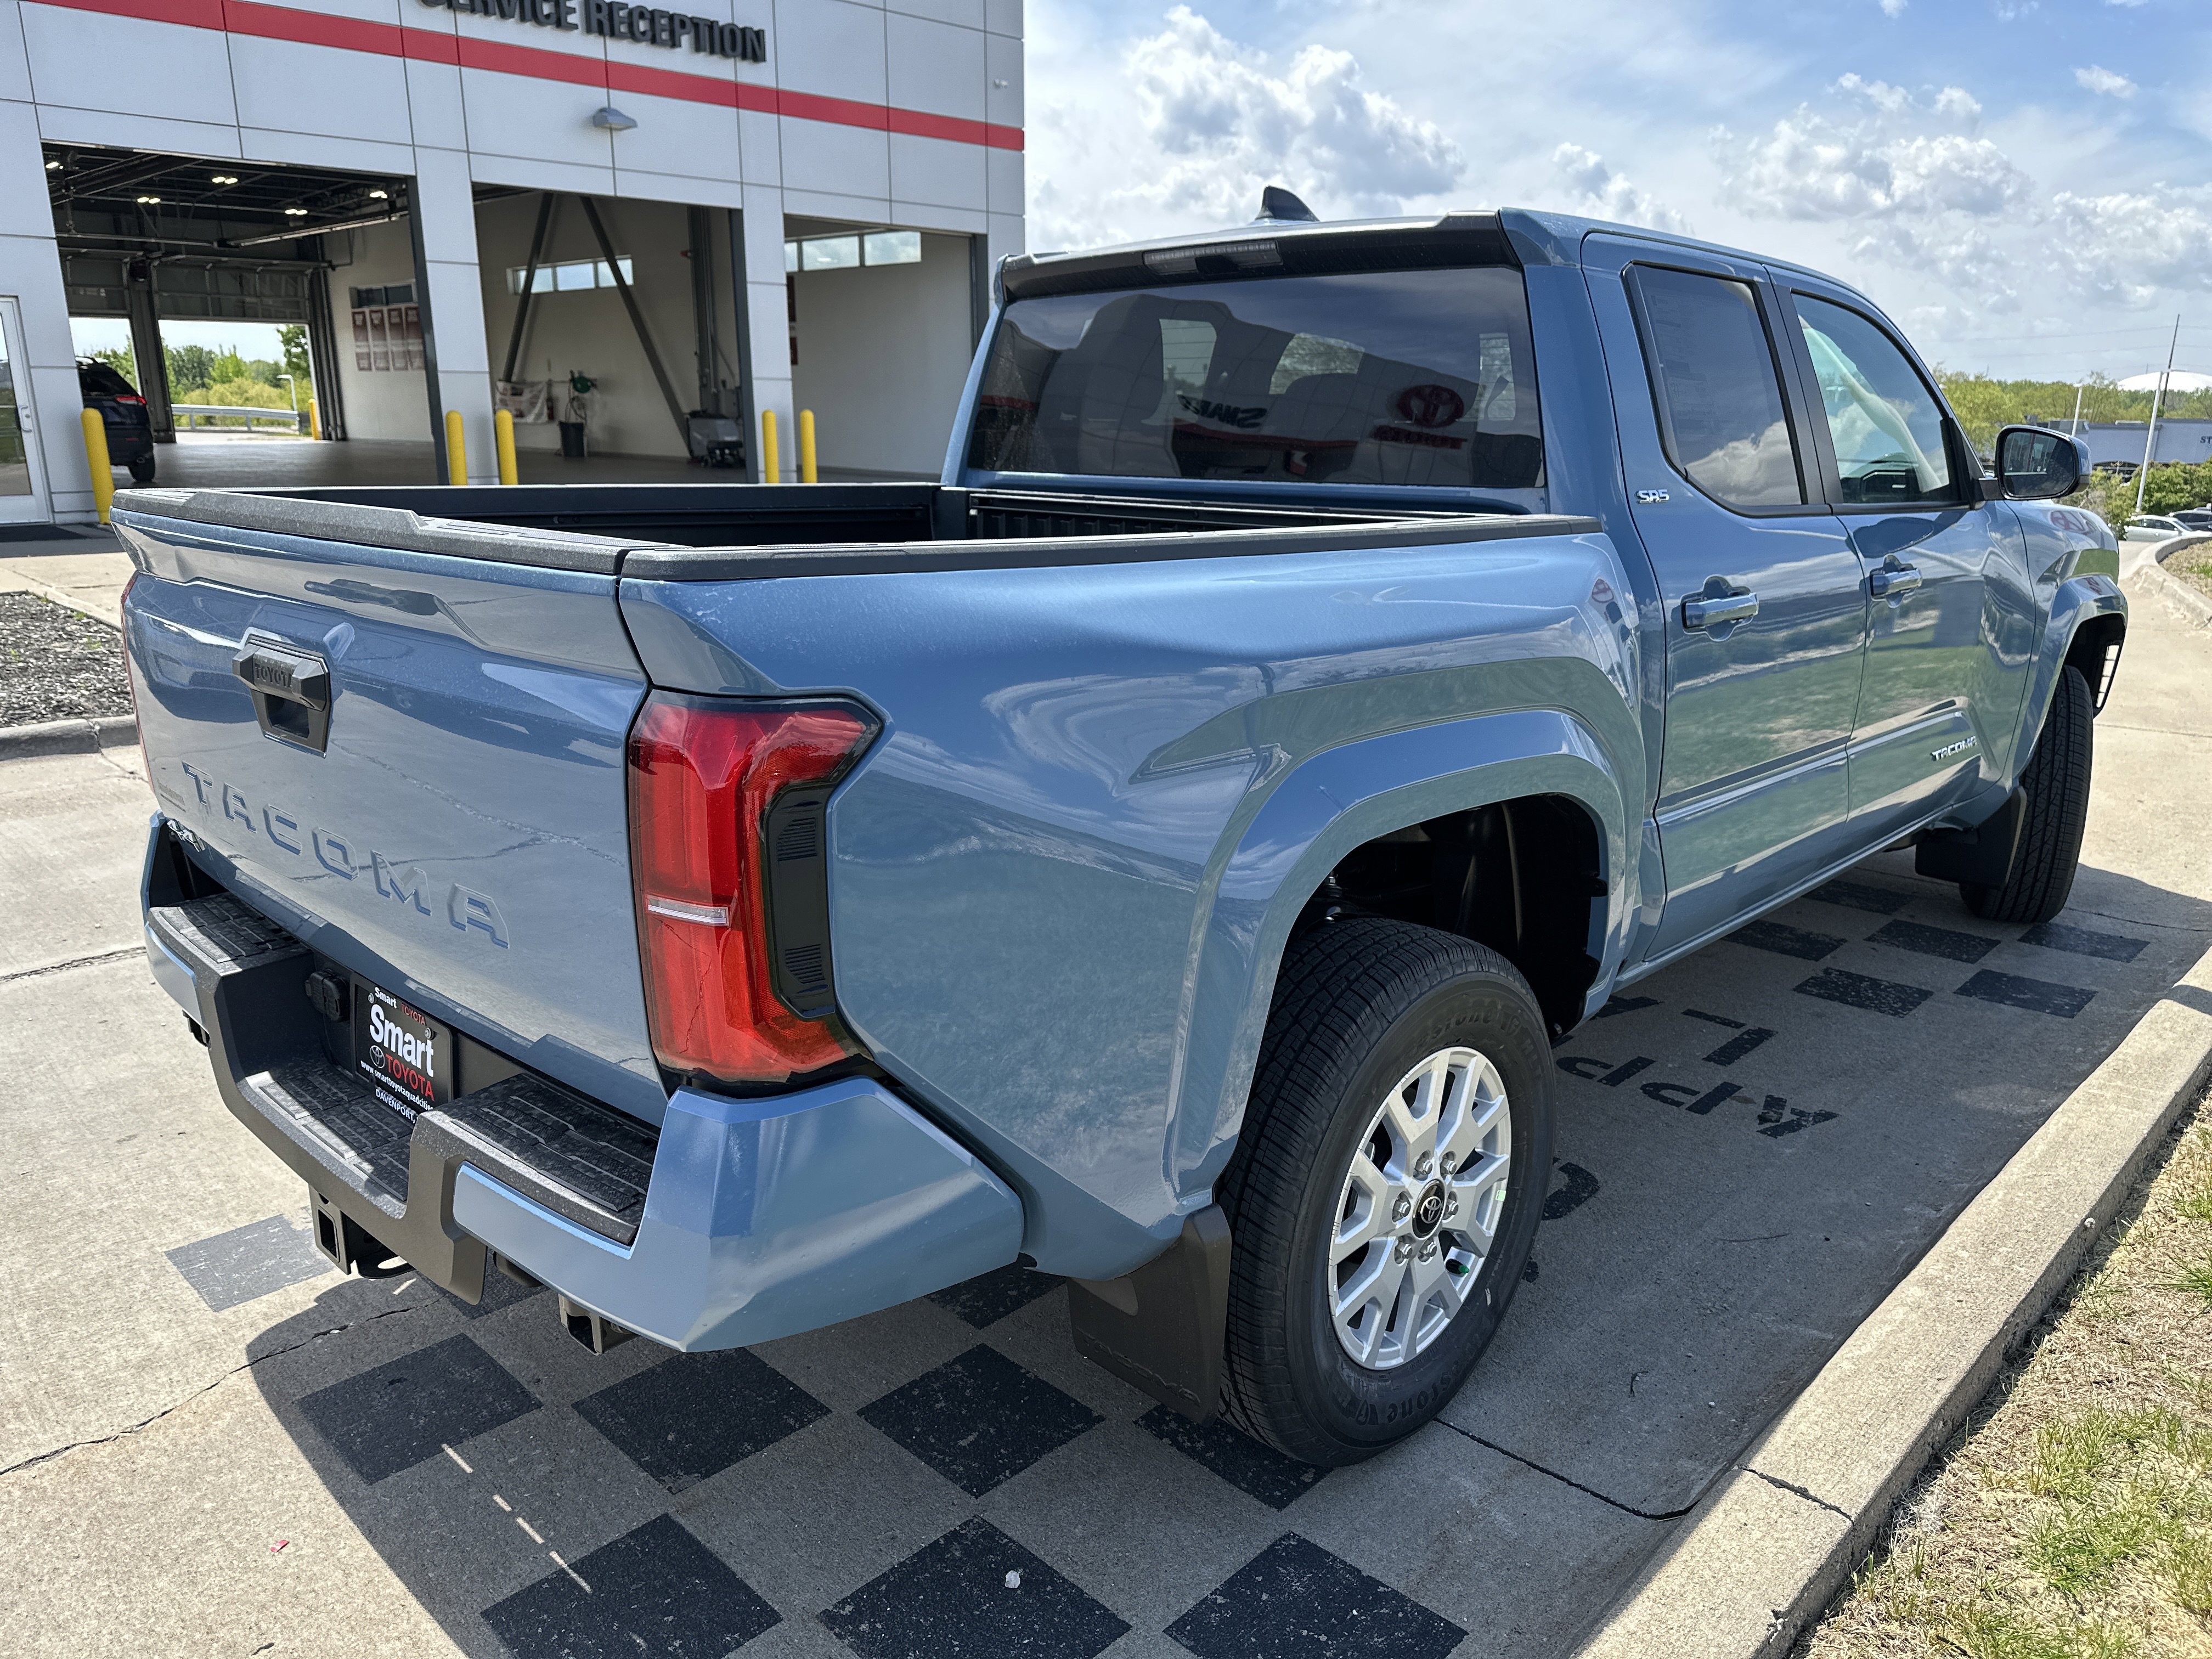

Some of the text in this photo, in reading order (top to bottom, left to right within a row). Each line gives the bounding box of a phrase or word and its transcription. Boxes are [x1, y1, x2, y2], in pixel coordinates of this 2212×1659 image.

[585, 0, 766, 63] RECEPTION
[1635, 489, 1669, 504] SR5
[1930, 735, 1977, 761] TACOMA
[182, 760, 511, 949] TACOMA
[375, 986, 427, 1026] Smart TOYOTA
[369, 1003, 434, 1077] Smart
[385, 1053, 435, 1102] TOYOTA
